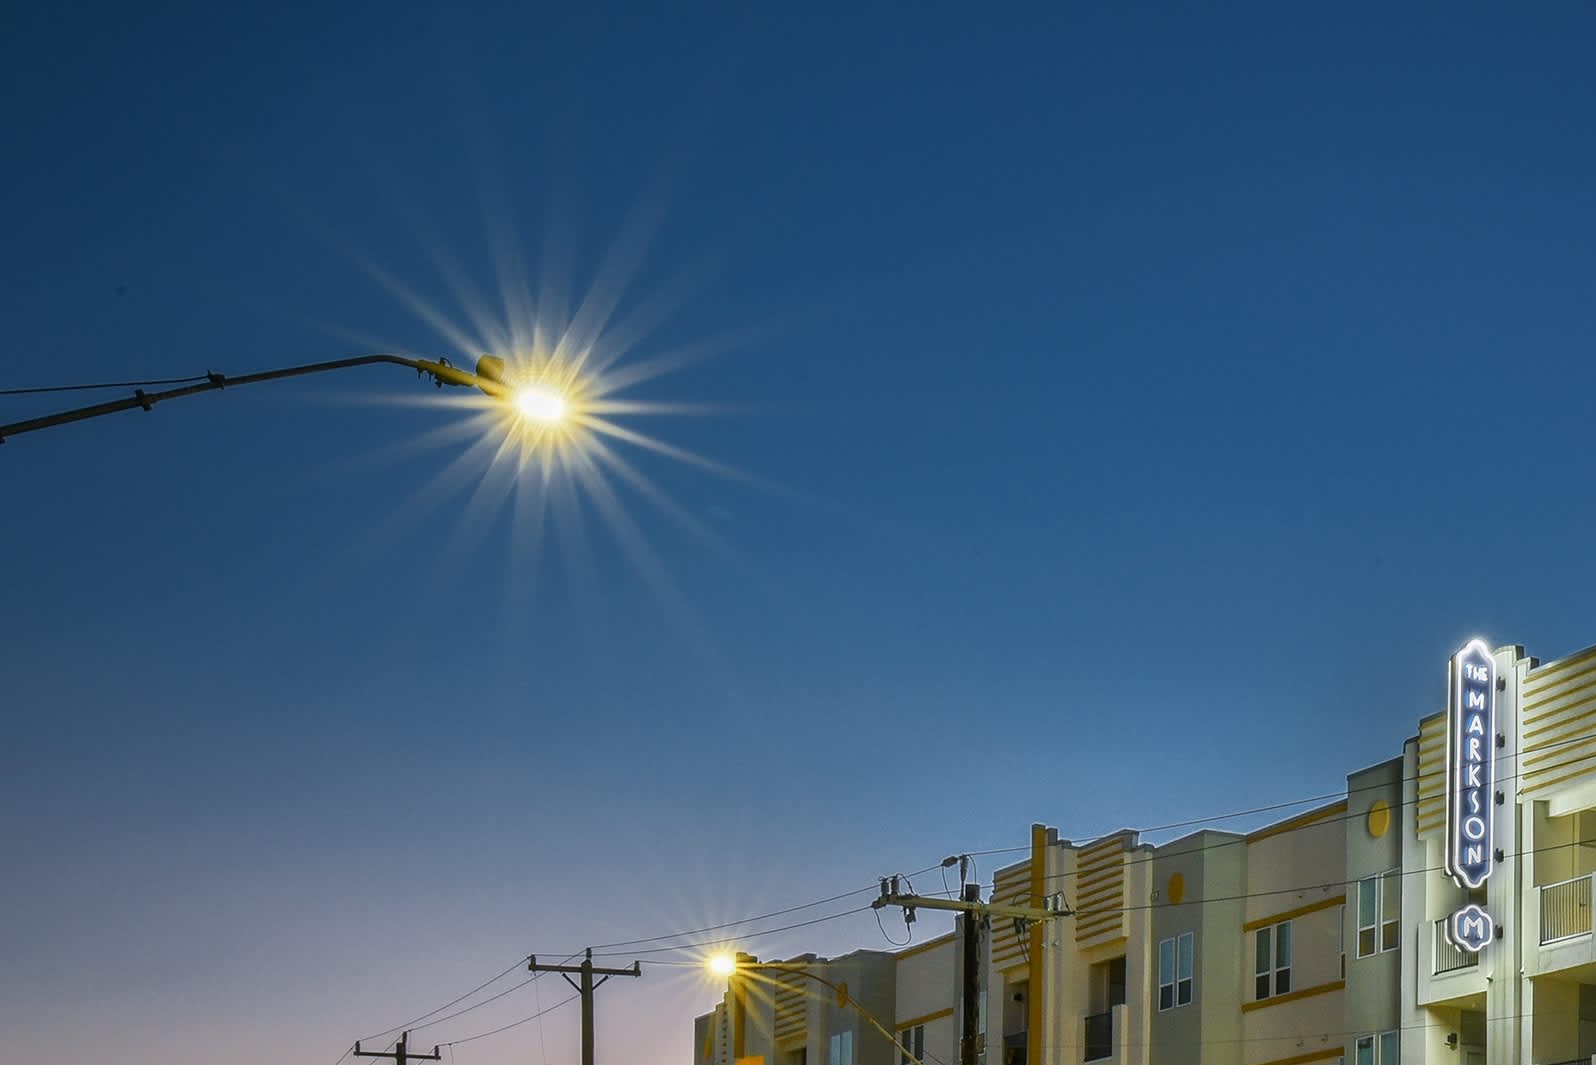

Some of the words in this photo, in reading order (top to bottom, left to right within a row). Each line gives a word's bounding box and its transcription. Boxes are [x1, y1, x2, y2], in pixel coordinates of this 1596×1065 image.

[1465, 664, 1488, 681] THE
[1465, 691, 1486, 865] MARKSON
[1464, 916, 1484, 939] M
